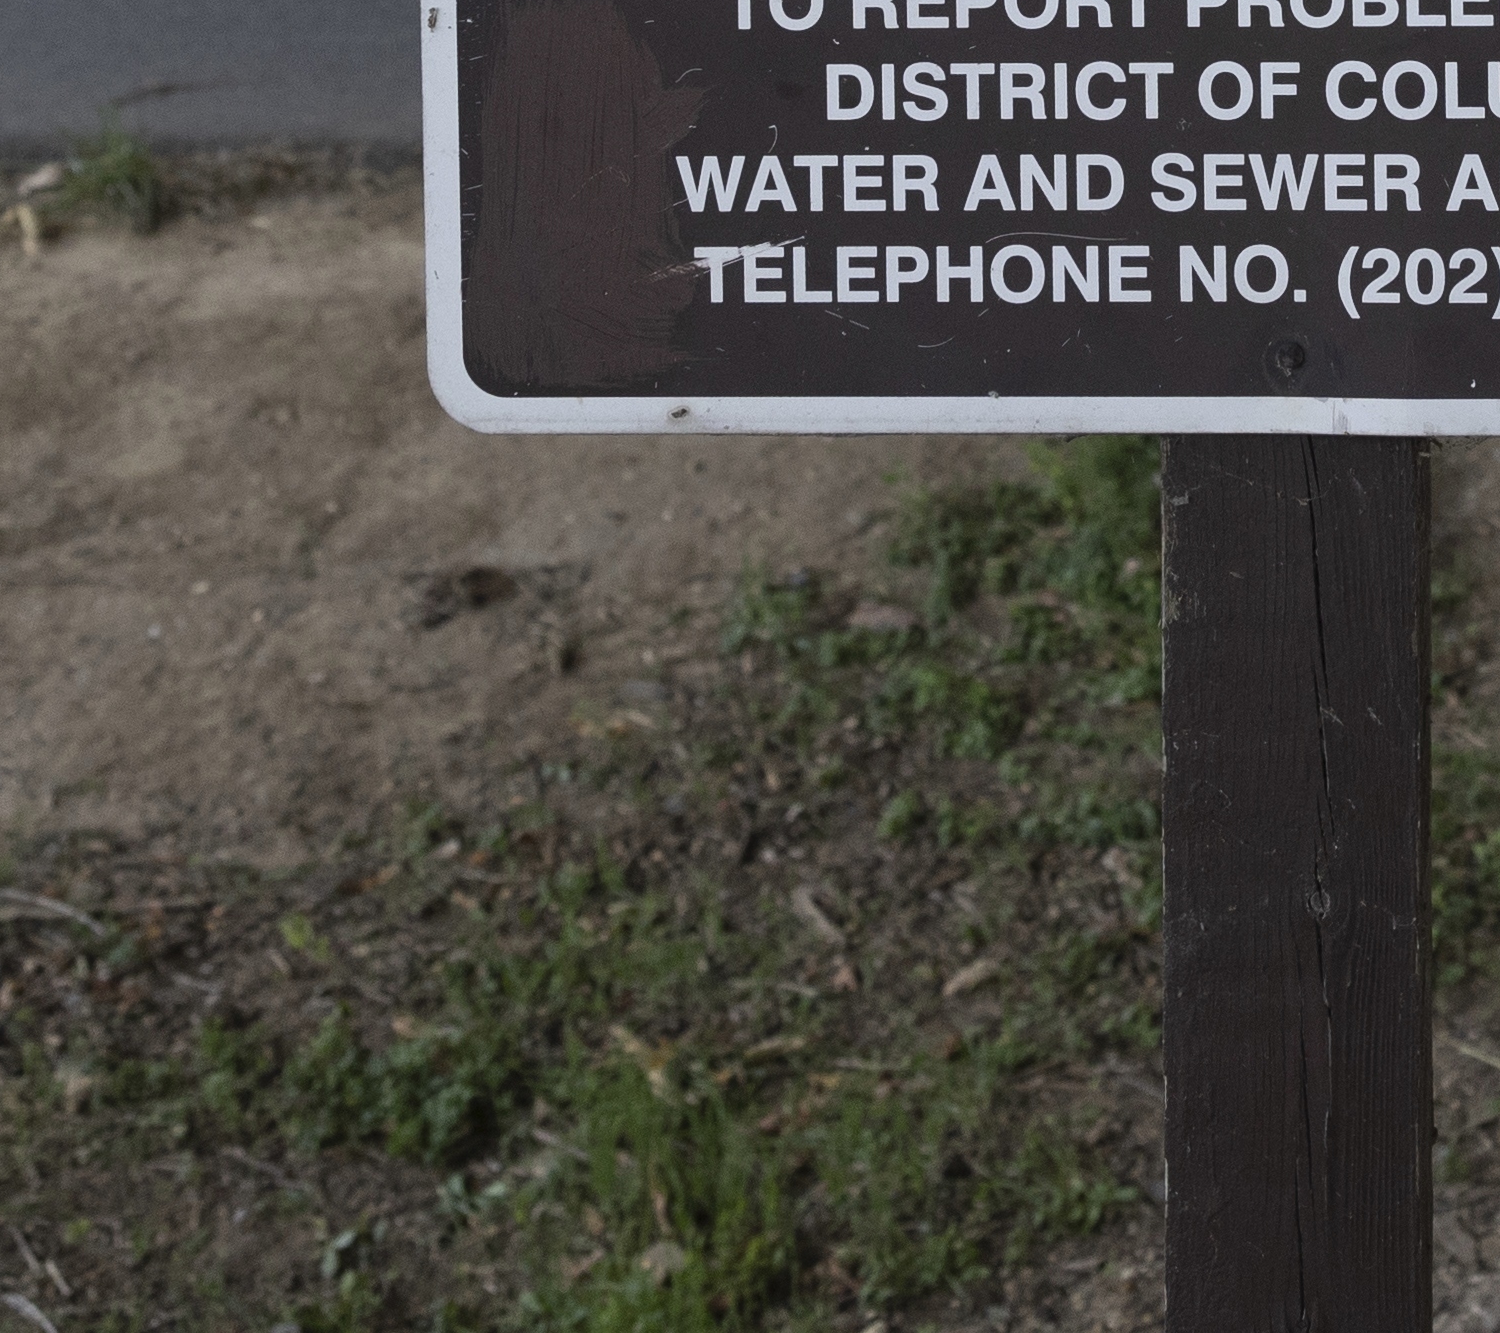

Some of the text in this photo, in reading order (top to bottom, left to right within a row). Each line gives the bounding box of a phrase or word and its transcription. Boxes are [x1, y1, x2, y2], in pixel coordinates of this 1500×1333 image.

[826, 61, 1174, 121] DISTRICT
[1198, 61, 1300, 120] OF
[676, 155, 939, 212] WATER
[964, 154, 1124, 211] AND
[1151, 153, 1421, 212] SEWER
[693, 244, 1152, 304] TELEPHONE
[1180, 244, 1306, 303] NO.
